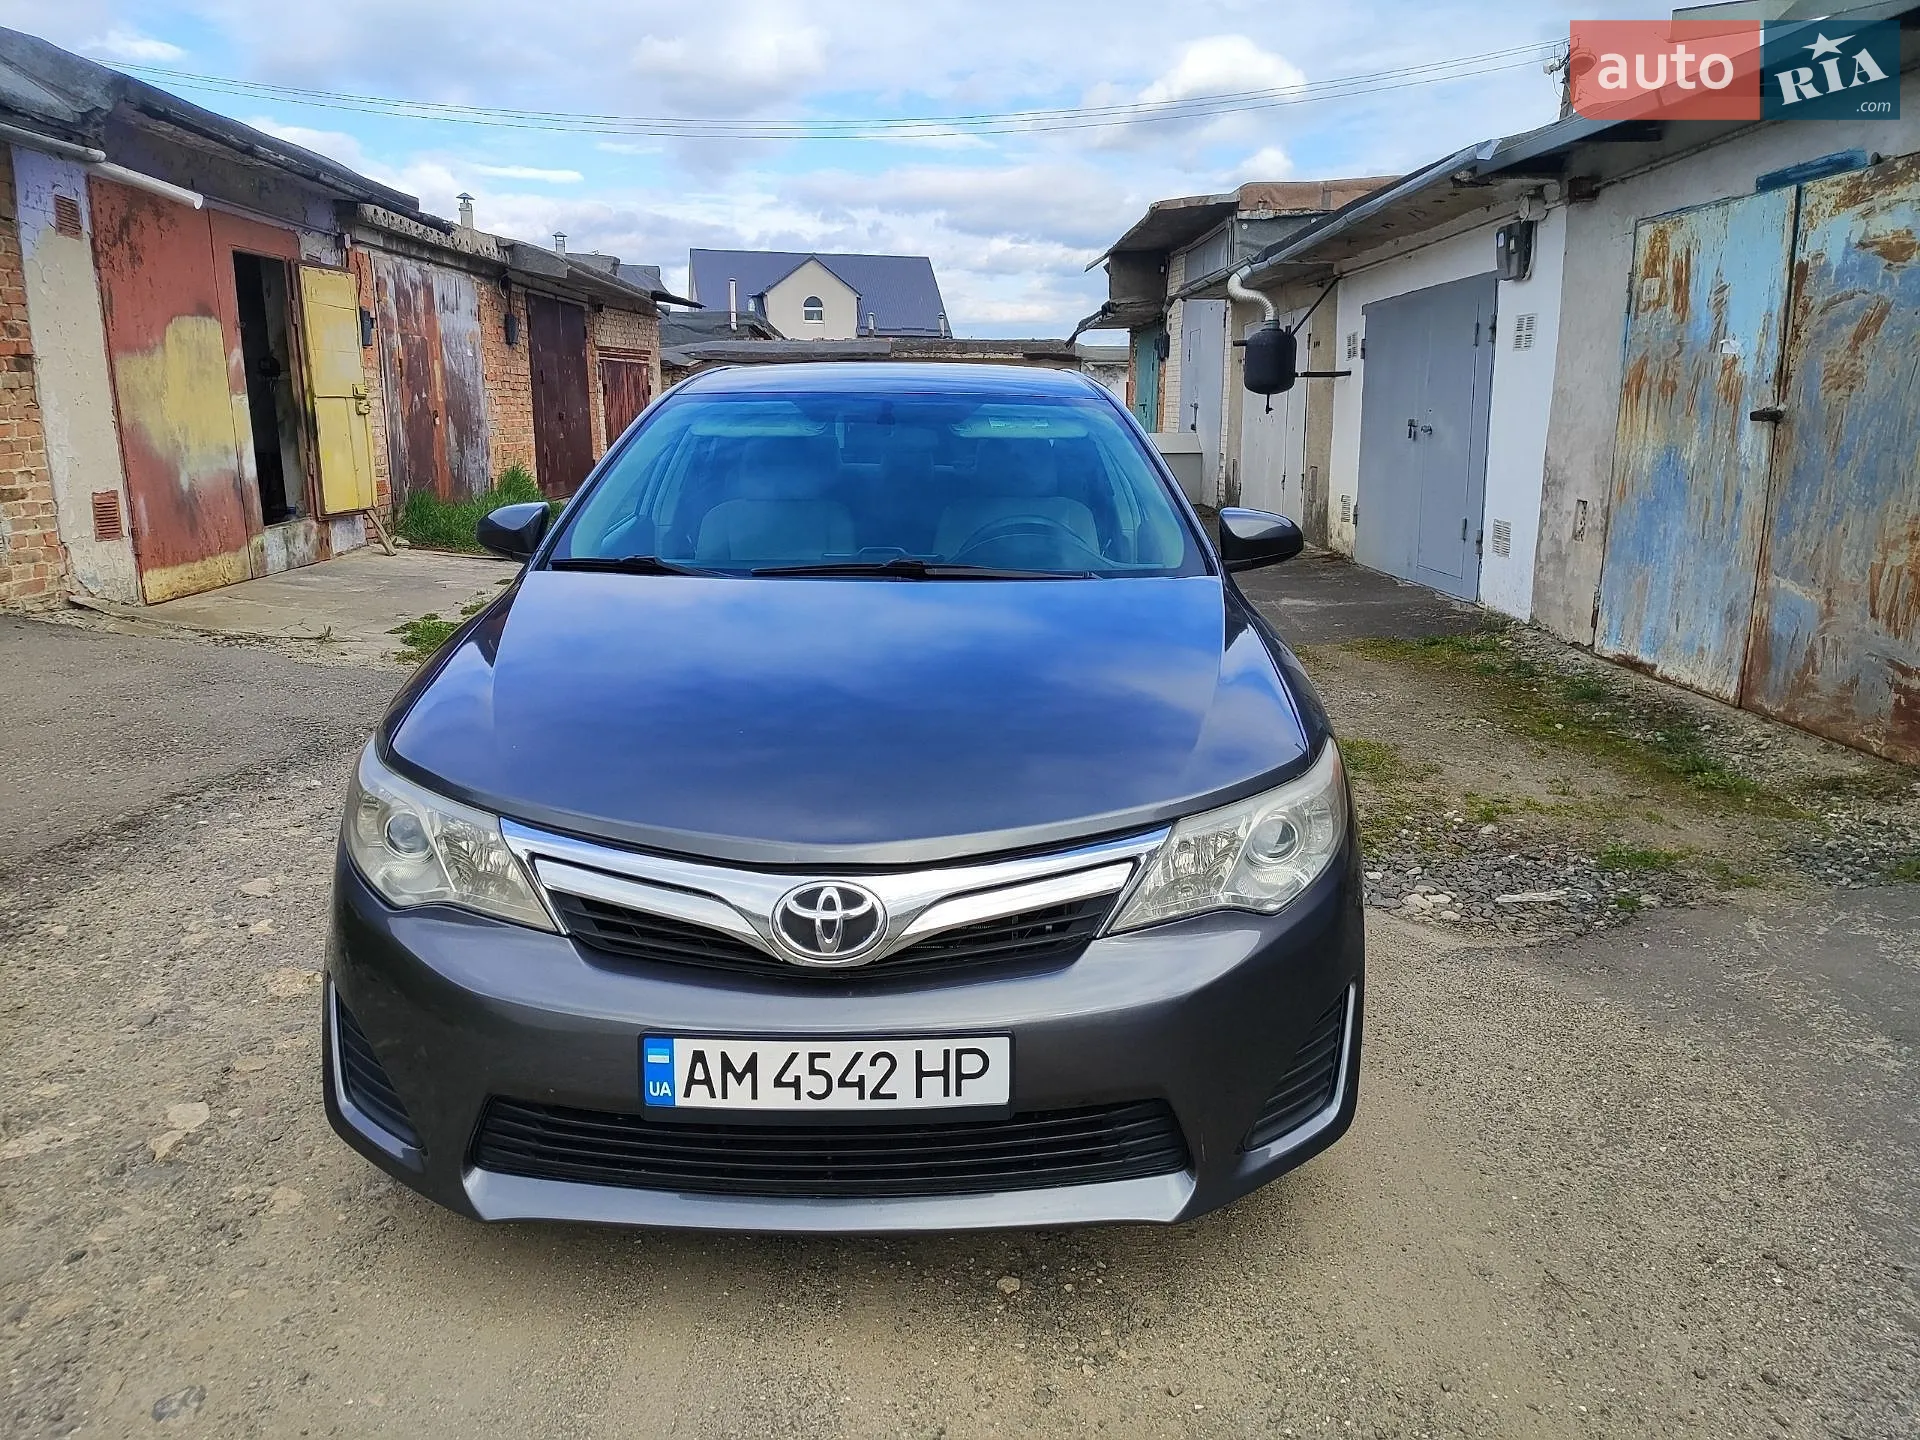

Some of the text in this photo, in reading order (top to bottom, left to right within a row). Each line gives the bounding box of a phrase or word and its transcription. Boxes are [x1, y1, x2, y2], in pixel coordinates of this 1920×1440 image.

[649, 1081, 672, 1097] UA
[683, 1047, 990, 1100] AM 4542 HP
